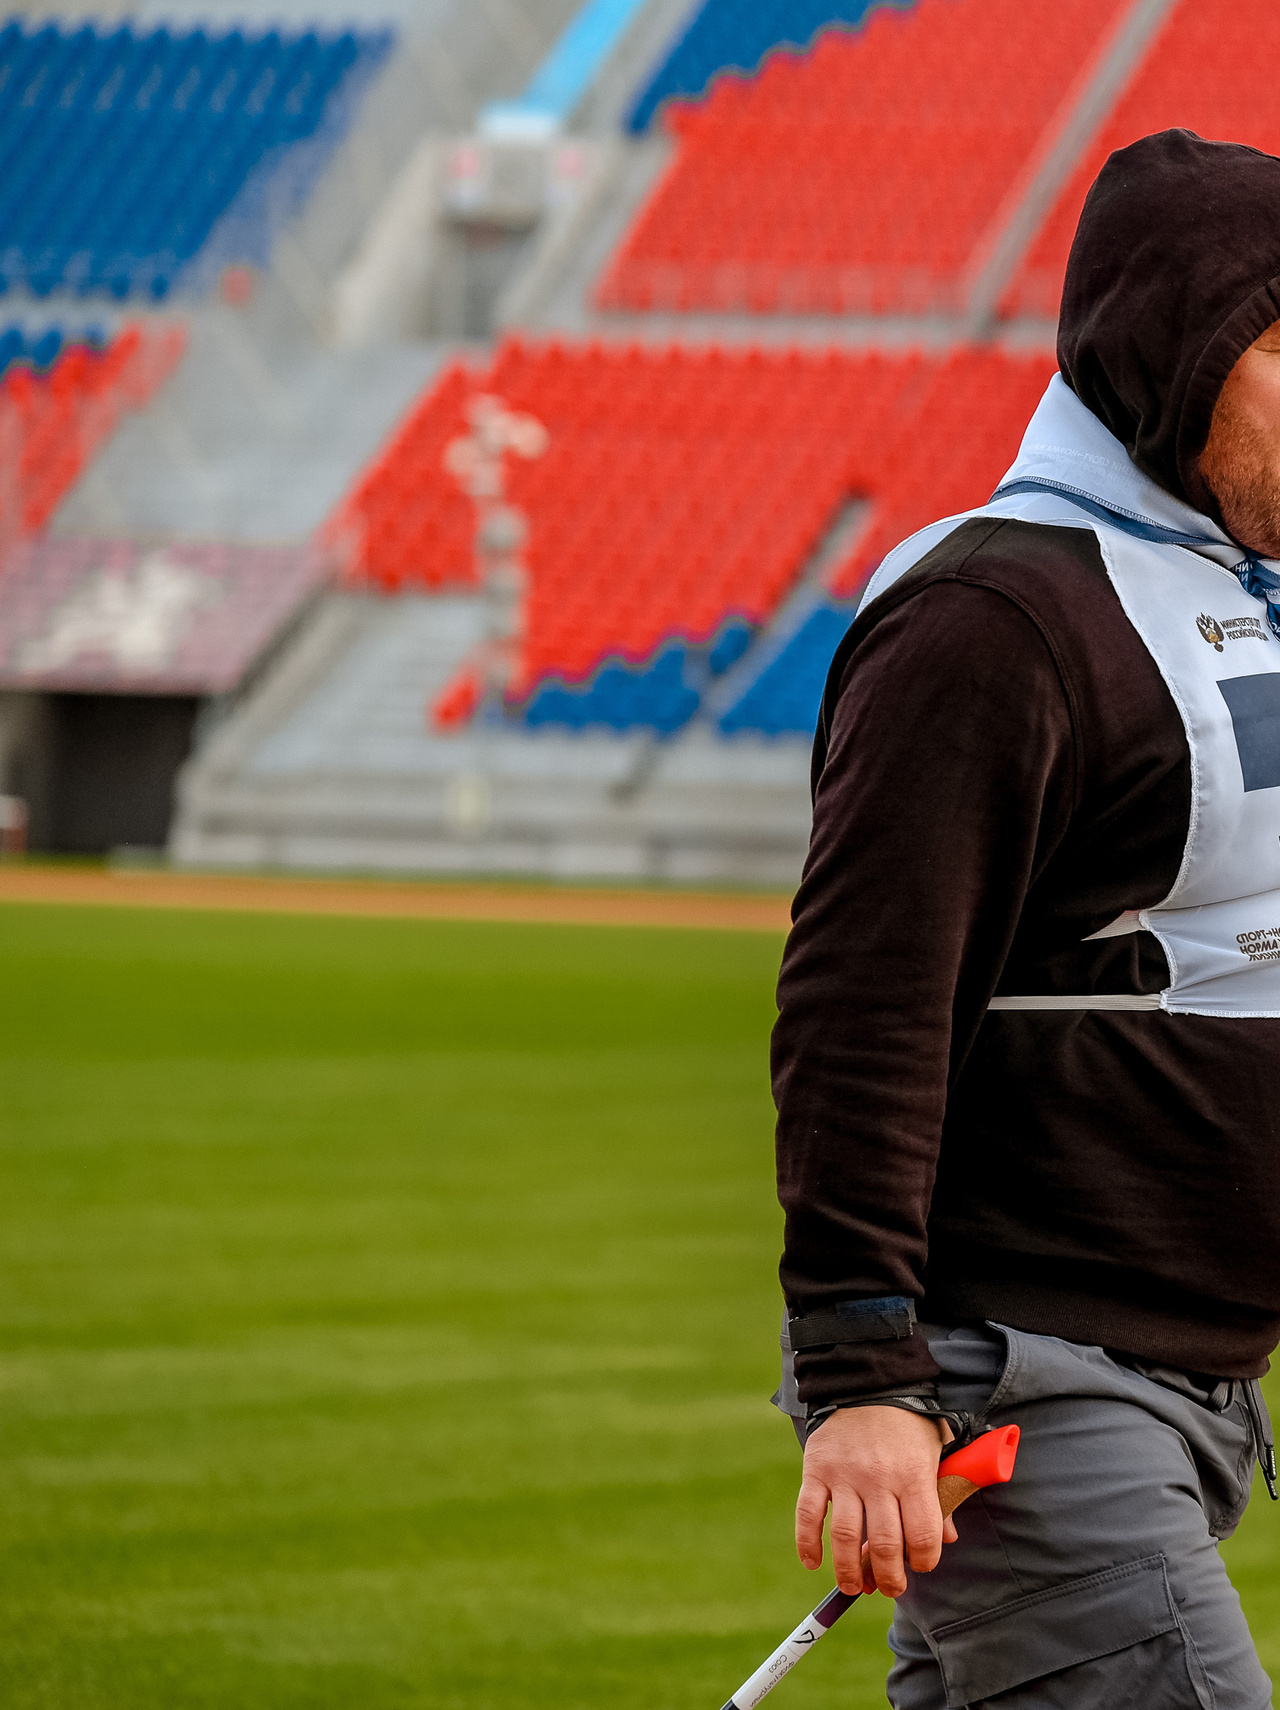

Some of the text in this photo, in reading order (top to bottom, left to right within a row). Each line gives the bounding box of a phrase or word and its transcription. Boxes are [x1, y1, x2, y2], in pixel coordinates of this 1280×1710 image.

[1236, 929, 1267, 944] СПОРТ
[1239, 939, 1279, 955] НОРМА
[768, 1653, 788, 1674] Союз
